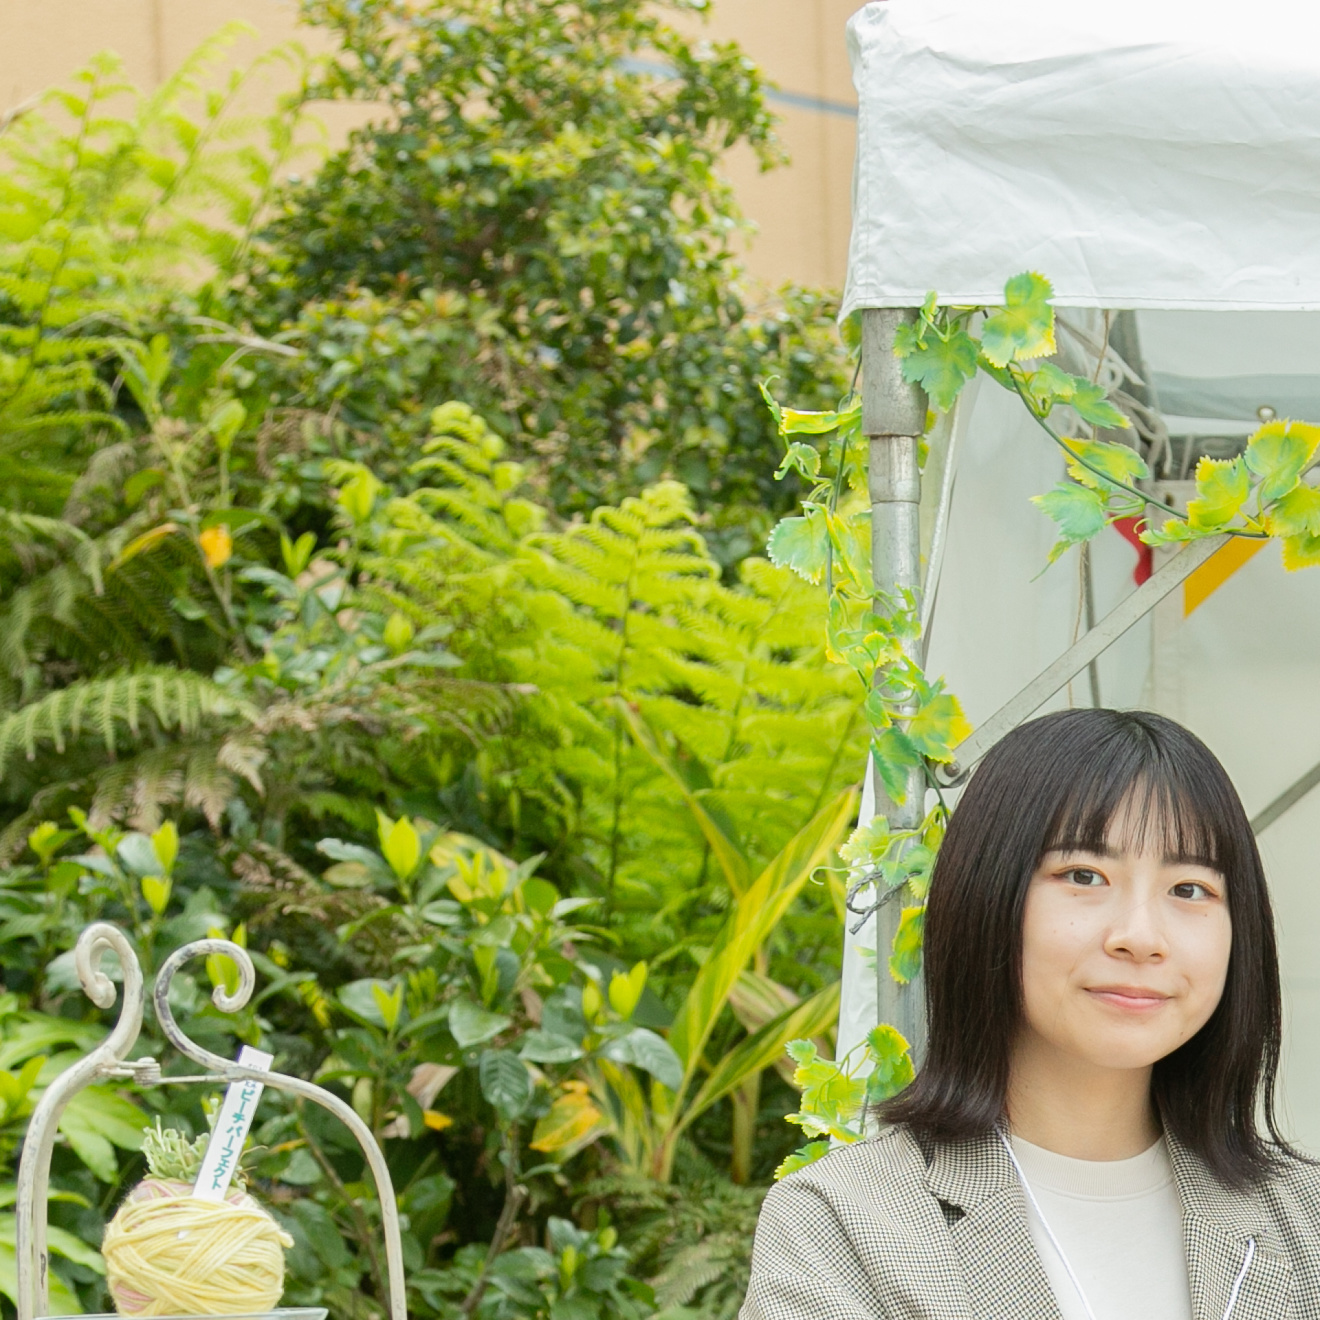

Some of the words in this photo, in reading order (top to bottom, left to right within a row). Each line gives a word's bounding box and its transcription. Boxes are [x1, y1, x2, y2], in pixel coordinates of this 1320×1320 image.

[211, 1089, 255, 1190] ビーチパーフェクト
